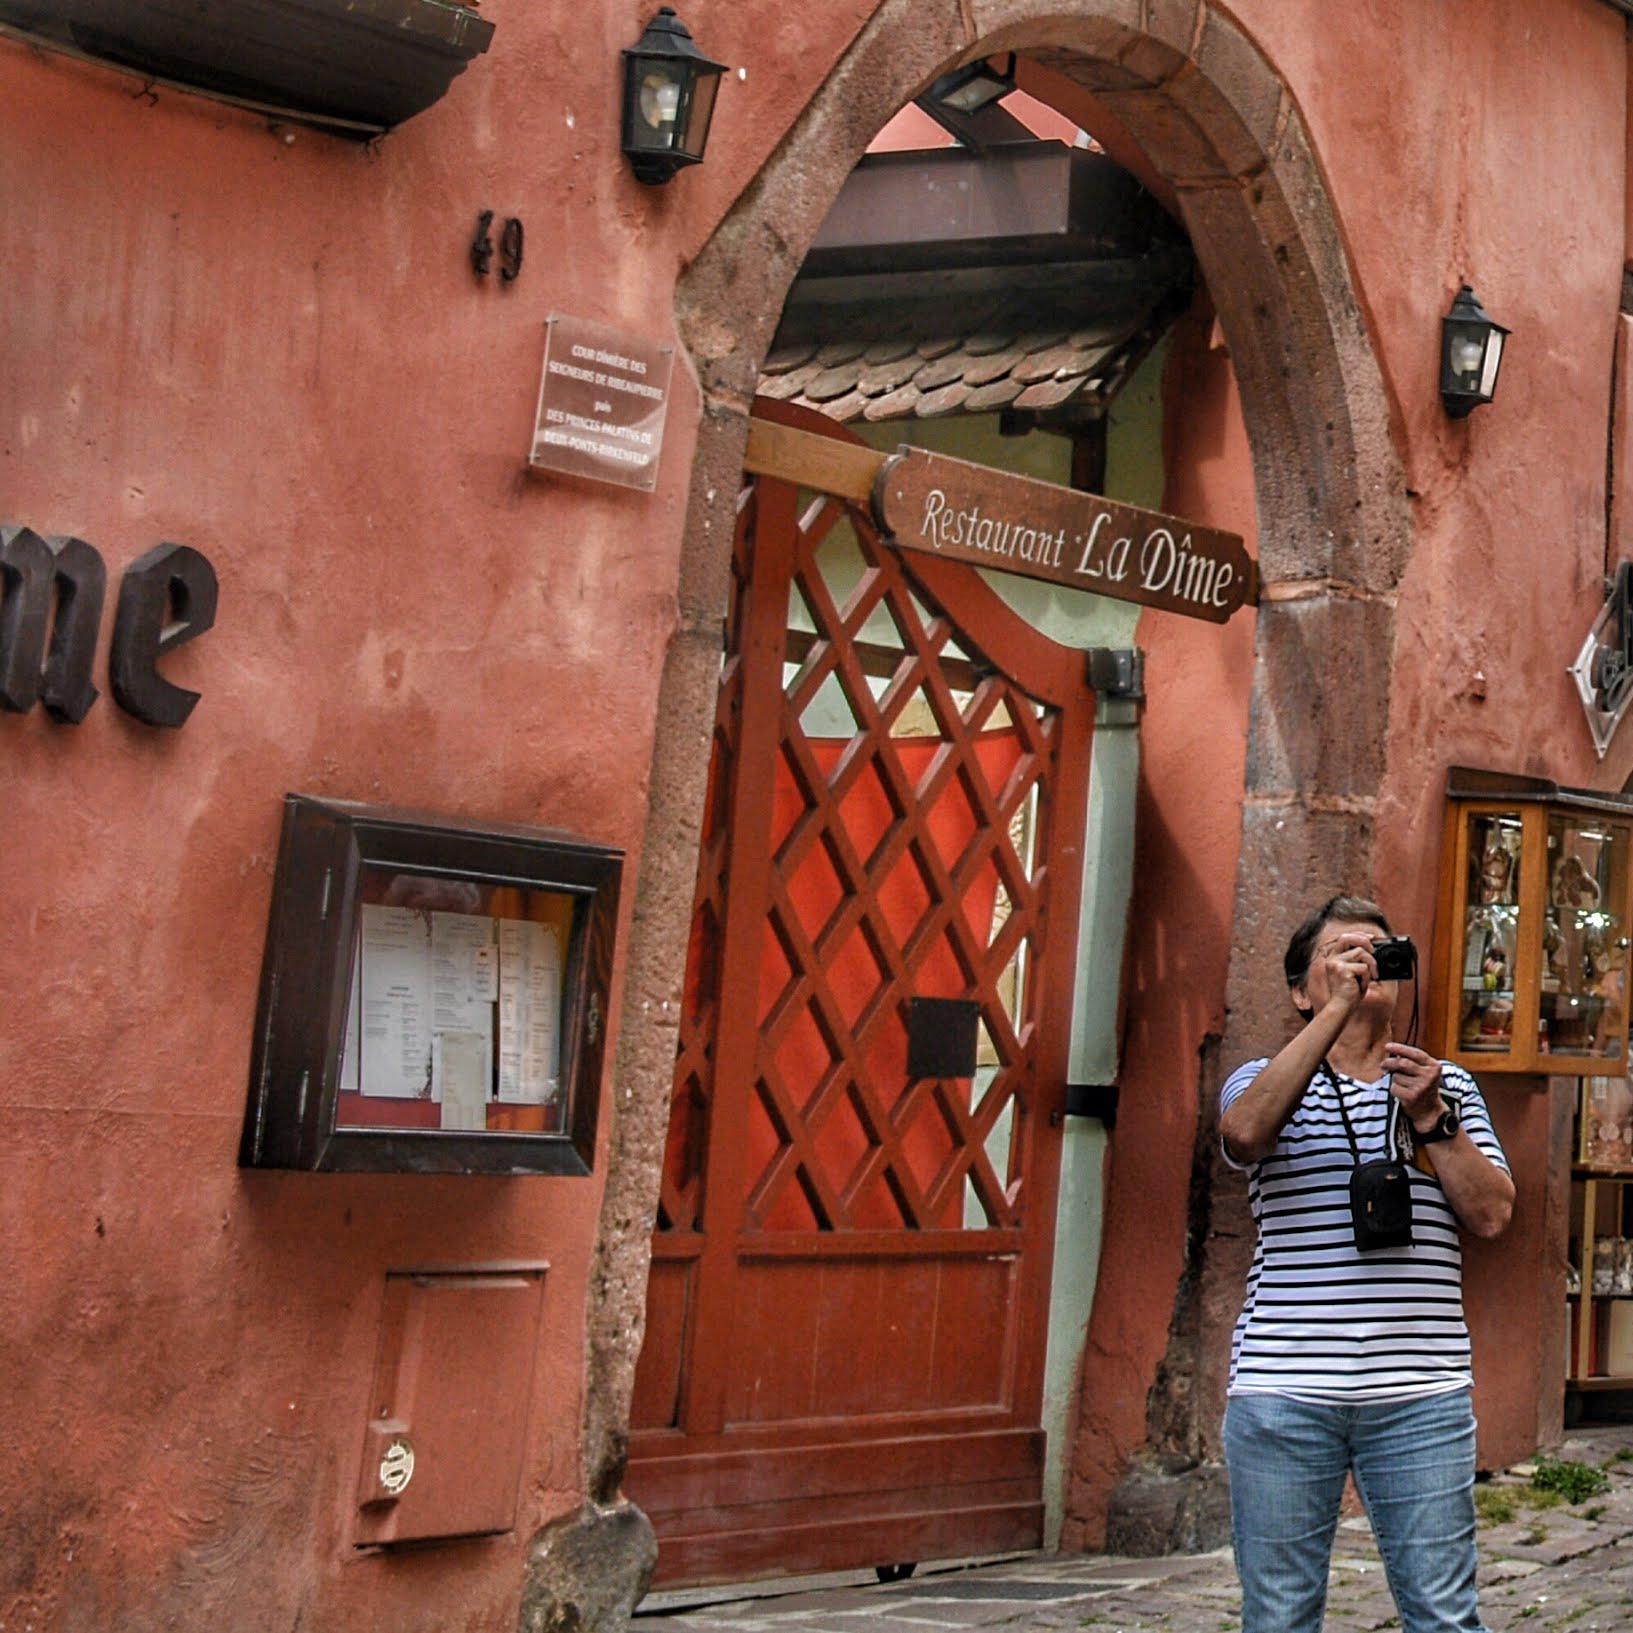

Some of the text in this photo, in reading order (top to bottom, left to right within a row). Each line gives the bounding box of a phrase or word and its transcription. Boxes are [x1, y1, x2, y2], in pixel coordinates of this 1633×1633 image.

[471, 210, 524, 282] 49
[571, 344, 596, 361] COUR
[630, 359, 647, 375] DES
[549, 360, 664, 400] SEIGNEURS DE RIBEAUPIERRE
[546, 409, 653, 446] DES PRINCES PALATINS DE
[920, 489, 1234, 608] Restaurant La Dîme
